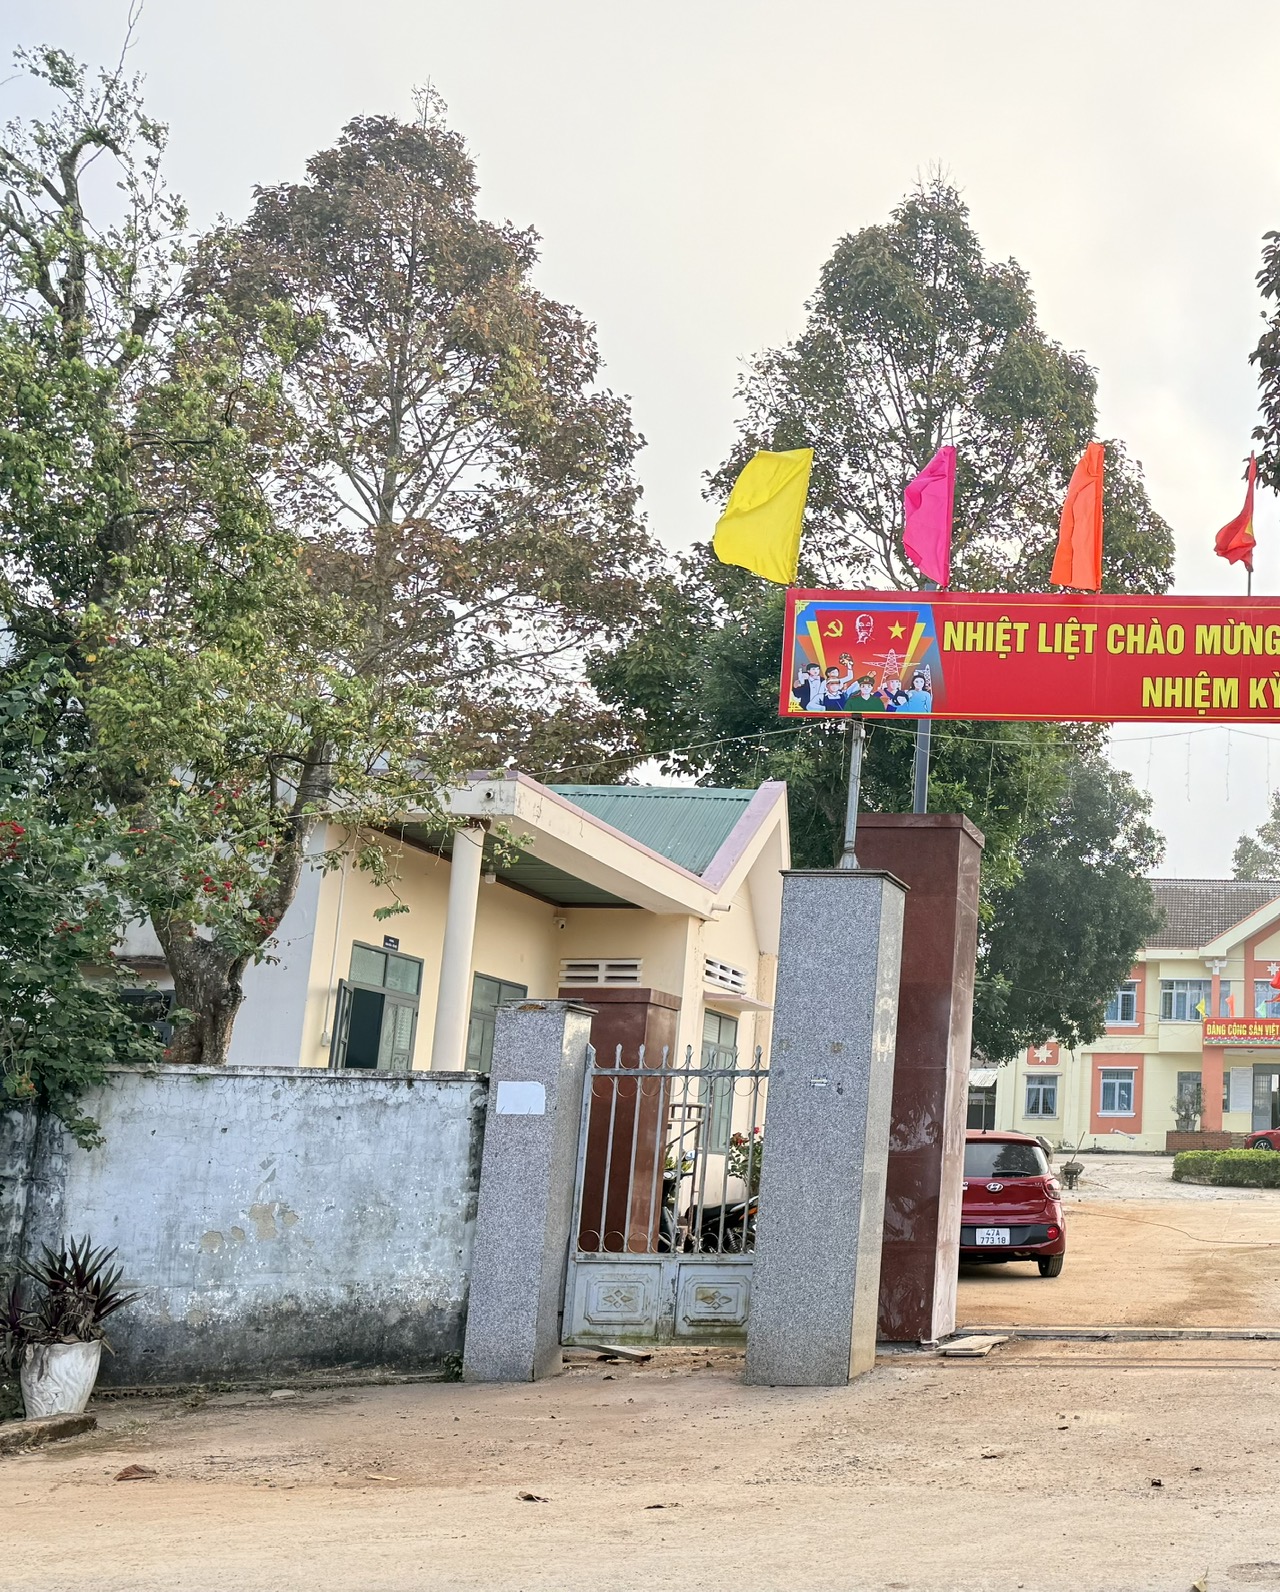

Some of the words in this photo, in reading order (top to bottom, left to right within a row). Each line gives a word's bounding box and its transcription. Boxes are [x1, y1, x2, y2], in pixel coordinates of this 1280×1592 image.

[943, 615, 1030, 660] NHIỆT
[1038, 616, 1098, 660] LIỆT
[1106, 618, 1185, 655] CHÀO
[1141, 671, 1239, 715] NHIỆM
[1206, 1021, 1226, 1035] ĐẢNG
[1228, 1022, 1247, 1037] CỘNG
[1248, 1021, 1263, 1035] SẢN
[1265, 1022, 1279, 1037] VIỆT
